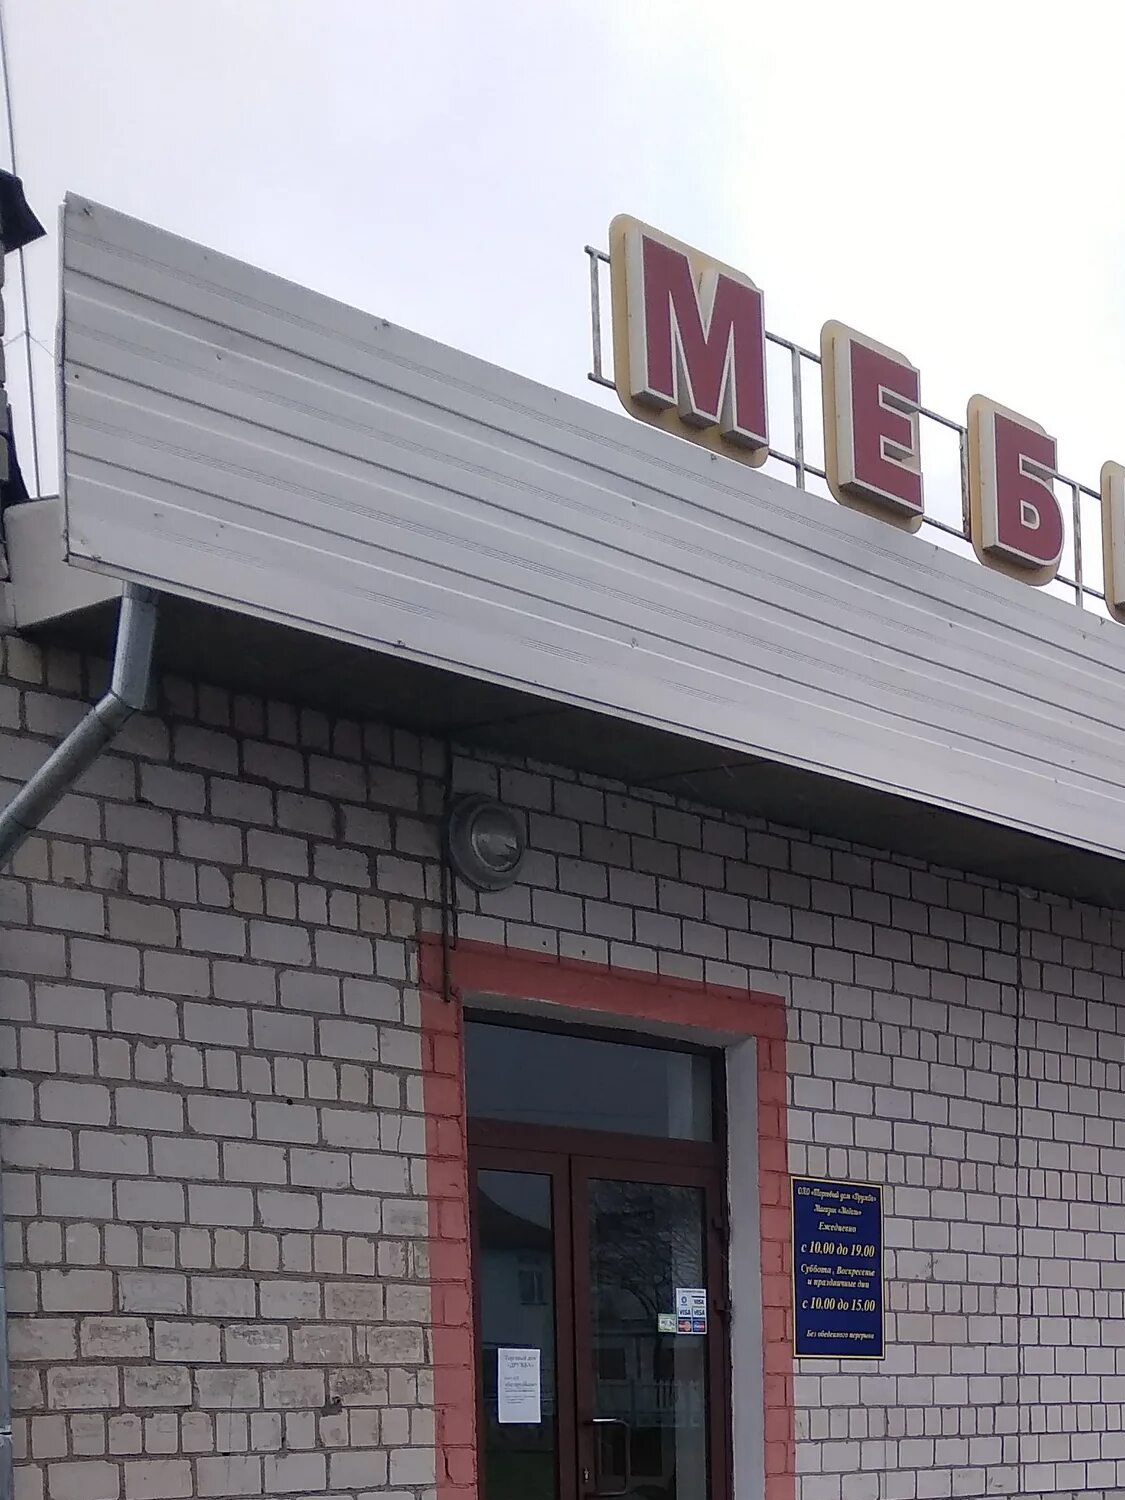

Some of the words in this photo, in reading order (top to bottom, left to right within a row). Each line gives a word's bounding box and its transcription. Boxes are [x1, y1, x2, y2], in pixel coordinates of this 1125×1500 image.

[818, 1221, 857, 1233] Ежедневно
[801, 1243, 807, 1253] с
[809, 1241, 835, 1255] 10.00
[836, 1243, 848, 1256] до
[850, 1244, 875, 1258] 19.00
[813, 1278, 857, 1288] праздничные
[857, 1280, 870, 1289] дни
[802, 1299, 808, 1309] с
[810, 1296, 836, 1310] 10.00
[837, 1298, 849, 1311] до
[851, 1298, 876, 1312] 15.00
[806, 1329, 817, 1338] Без
[817, 1330, 848, 1338] обеденного
